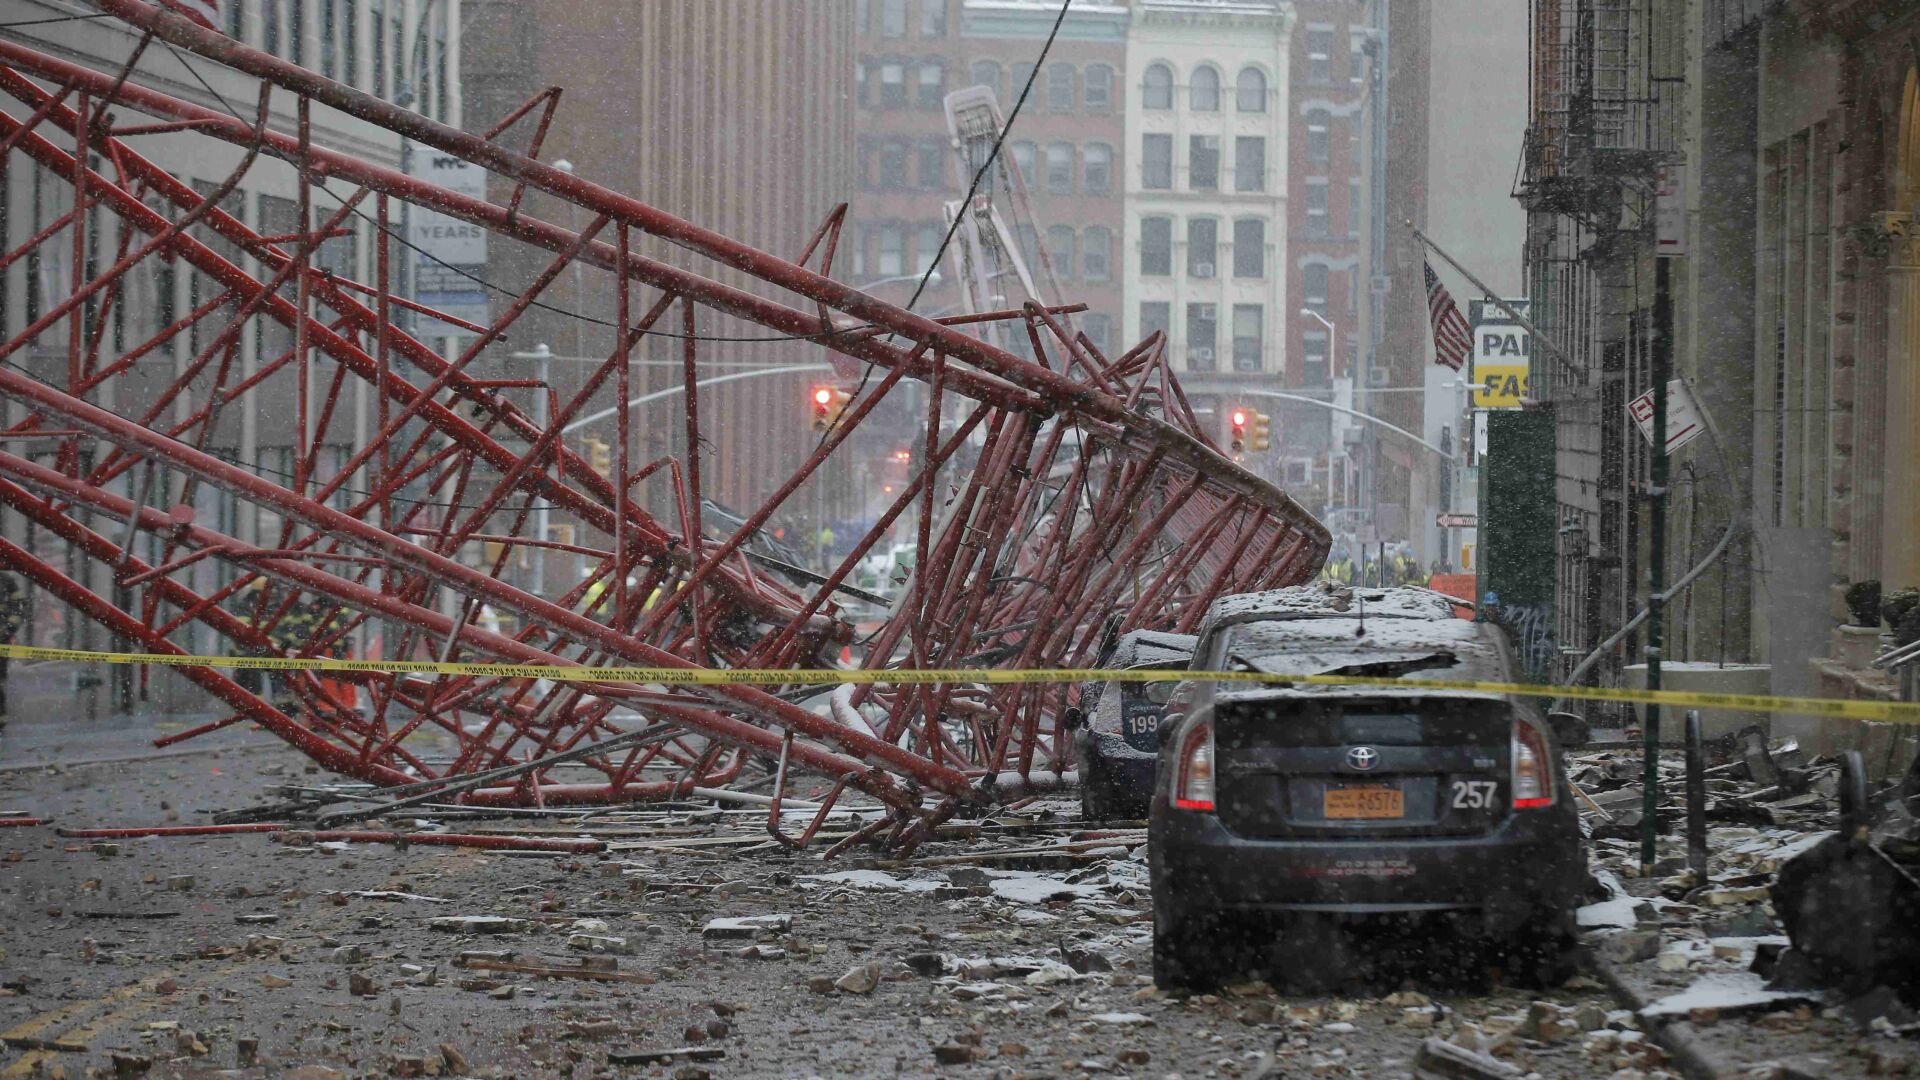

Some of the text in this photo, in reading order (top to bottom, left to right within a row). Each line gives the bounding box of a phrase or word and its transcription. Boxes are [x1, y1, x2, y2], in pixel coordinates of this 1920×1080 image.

[419, 226, 482, 239] YEARS
[1129, 714, 1158, 735] 199
[1452, 780, 1498, 809] 257
